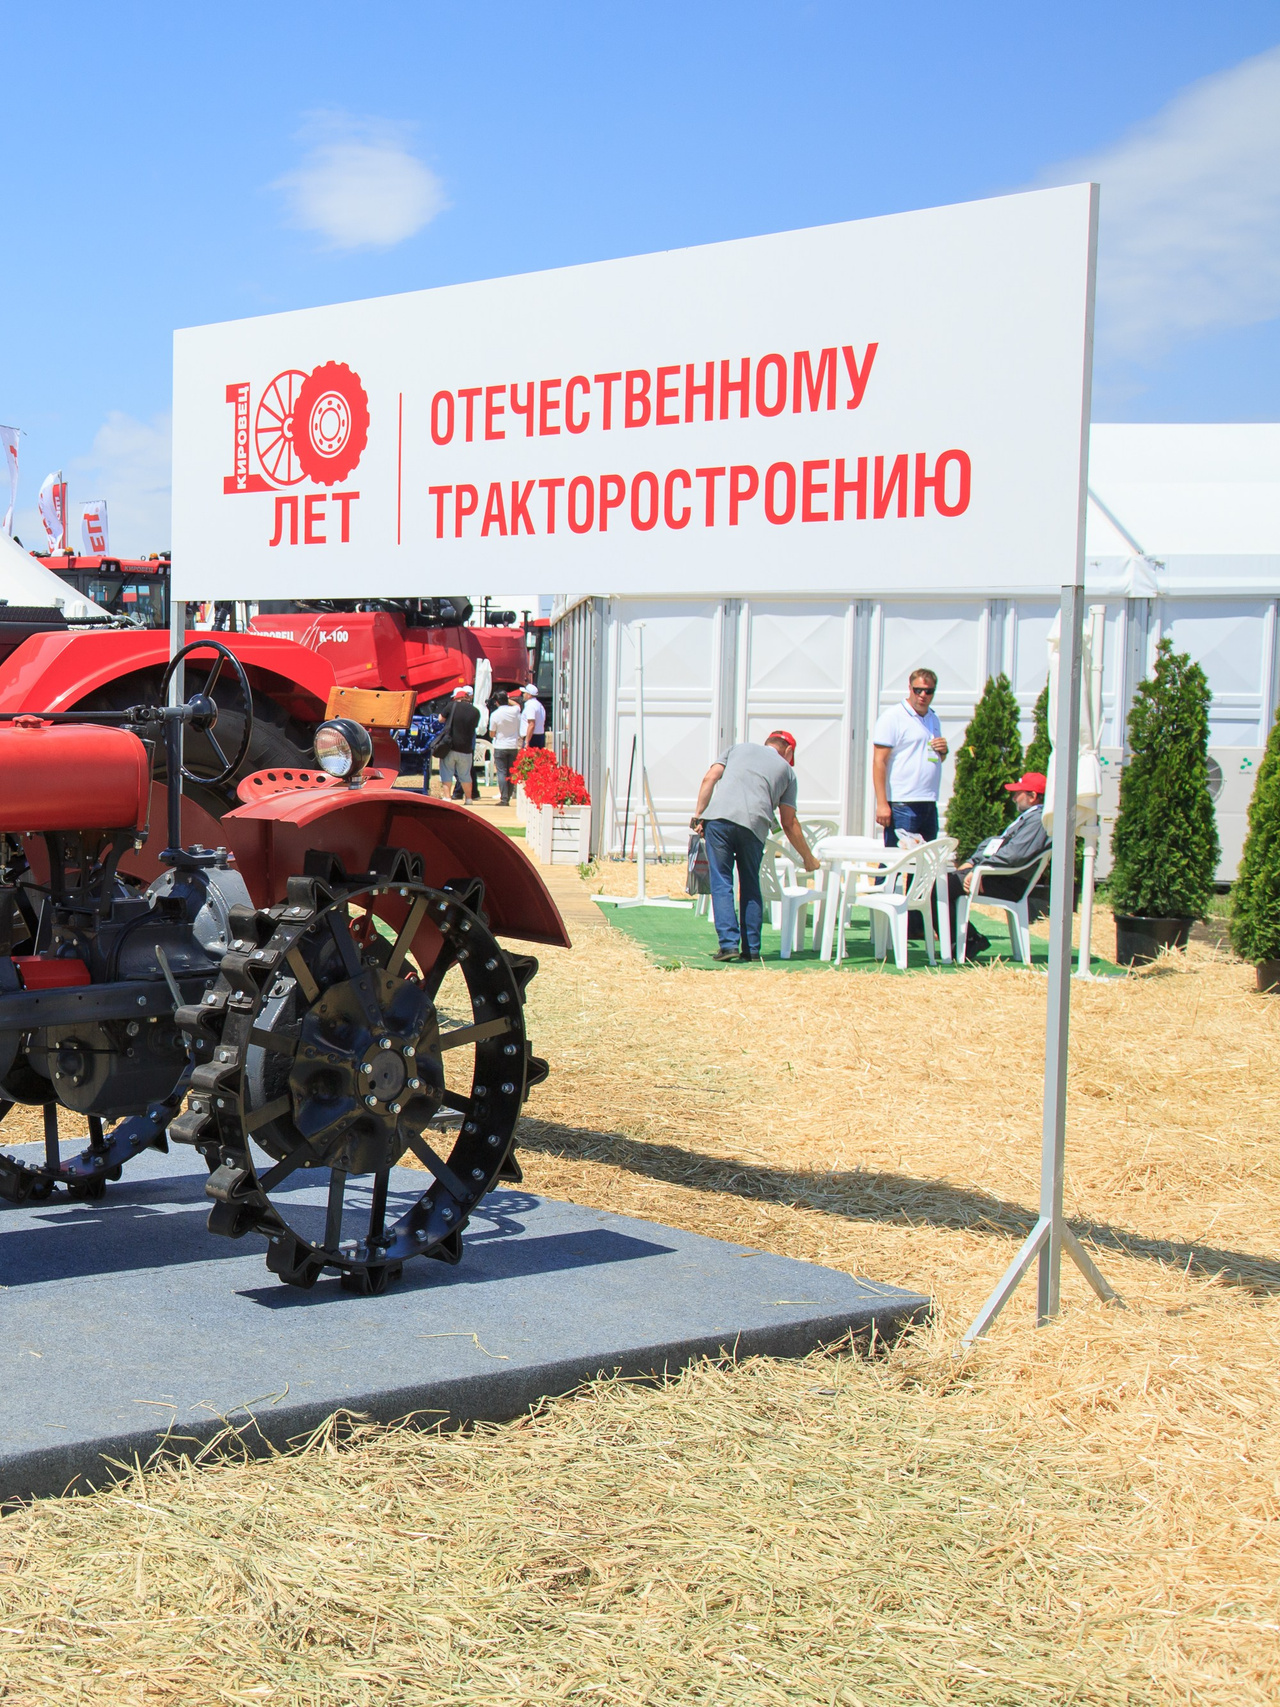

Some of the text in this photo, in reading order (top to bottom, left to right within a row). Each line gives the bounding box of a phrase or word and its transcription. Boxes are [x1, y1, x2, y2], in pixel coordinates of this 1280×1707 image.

[237, 385, 250, 490] КИРОВЕЦ
[430, 342, 879, 446] ОТЕЧЕСТВЕННОМУ
[269, 490, 361, 548] ЛЕТ
[428, 448, 972, 539] ТРАКТОРОСТРОЕНИЮ
